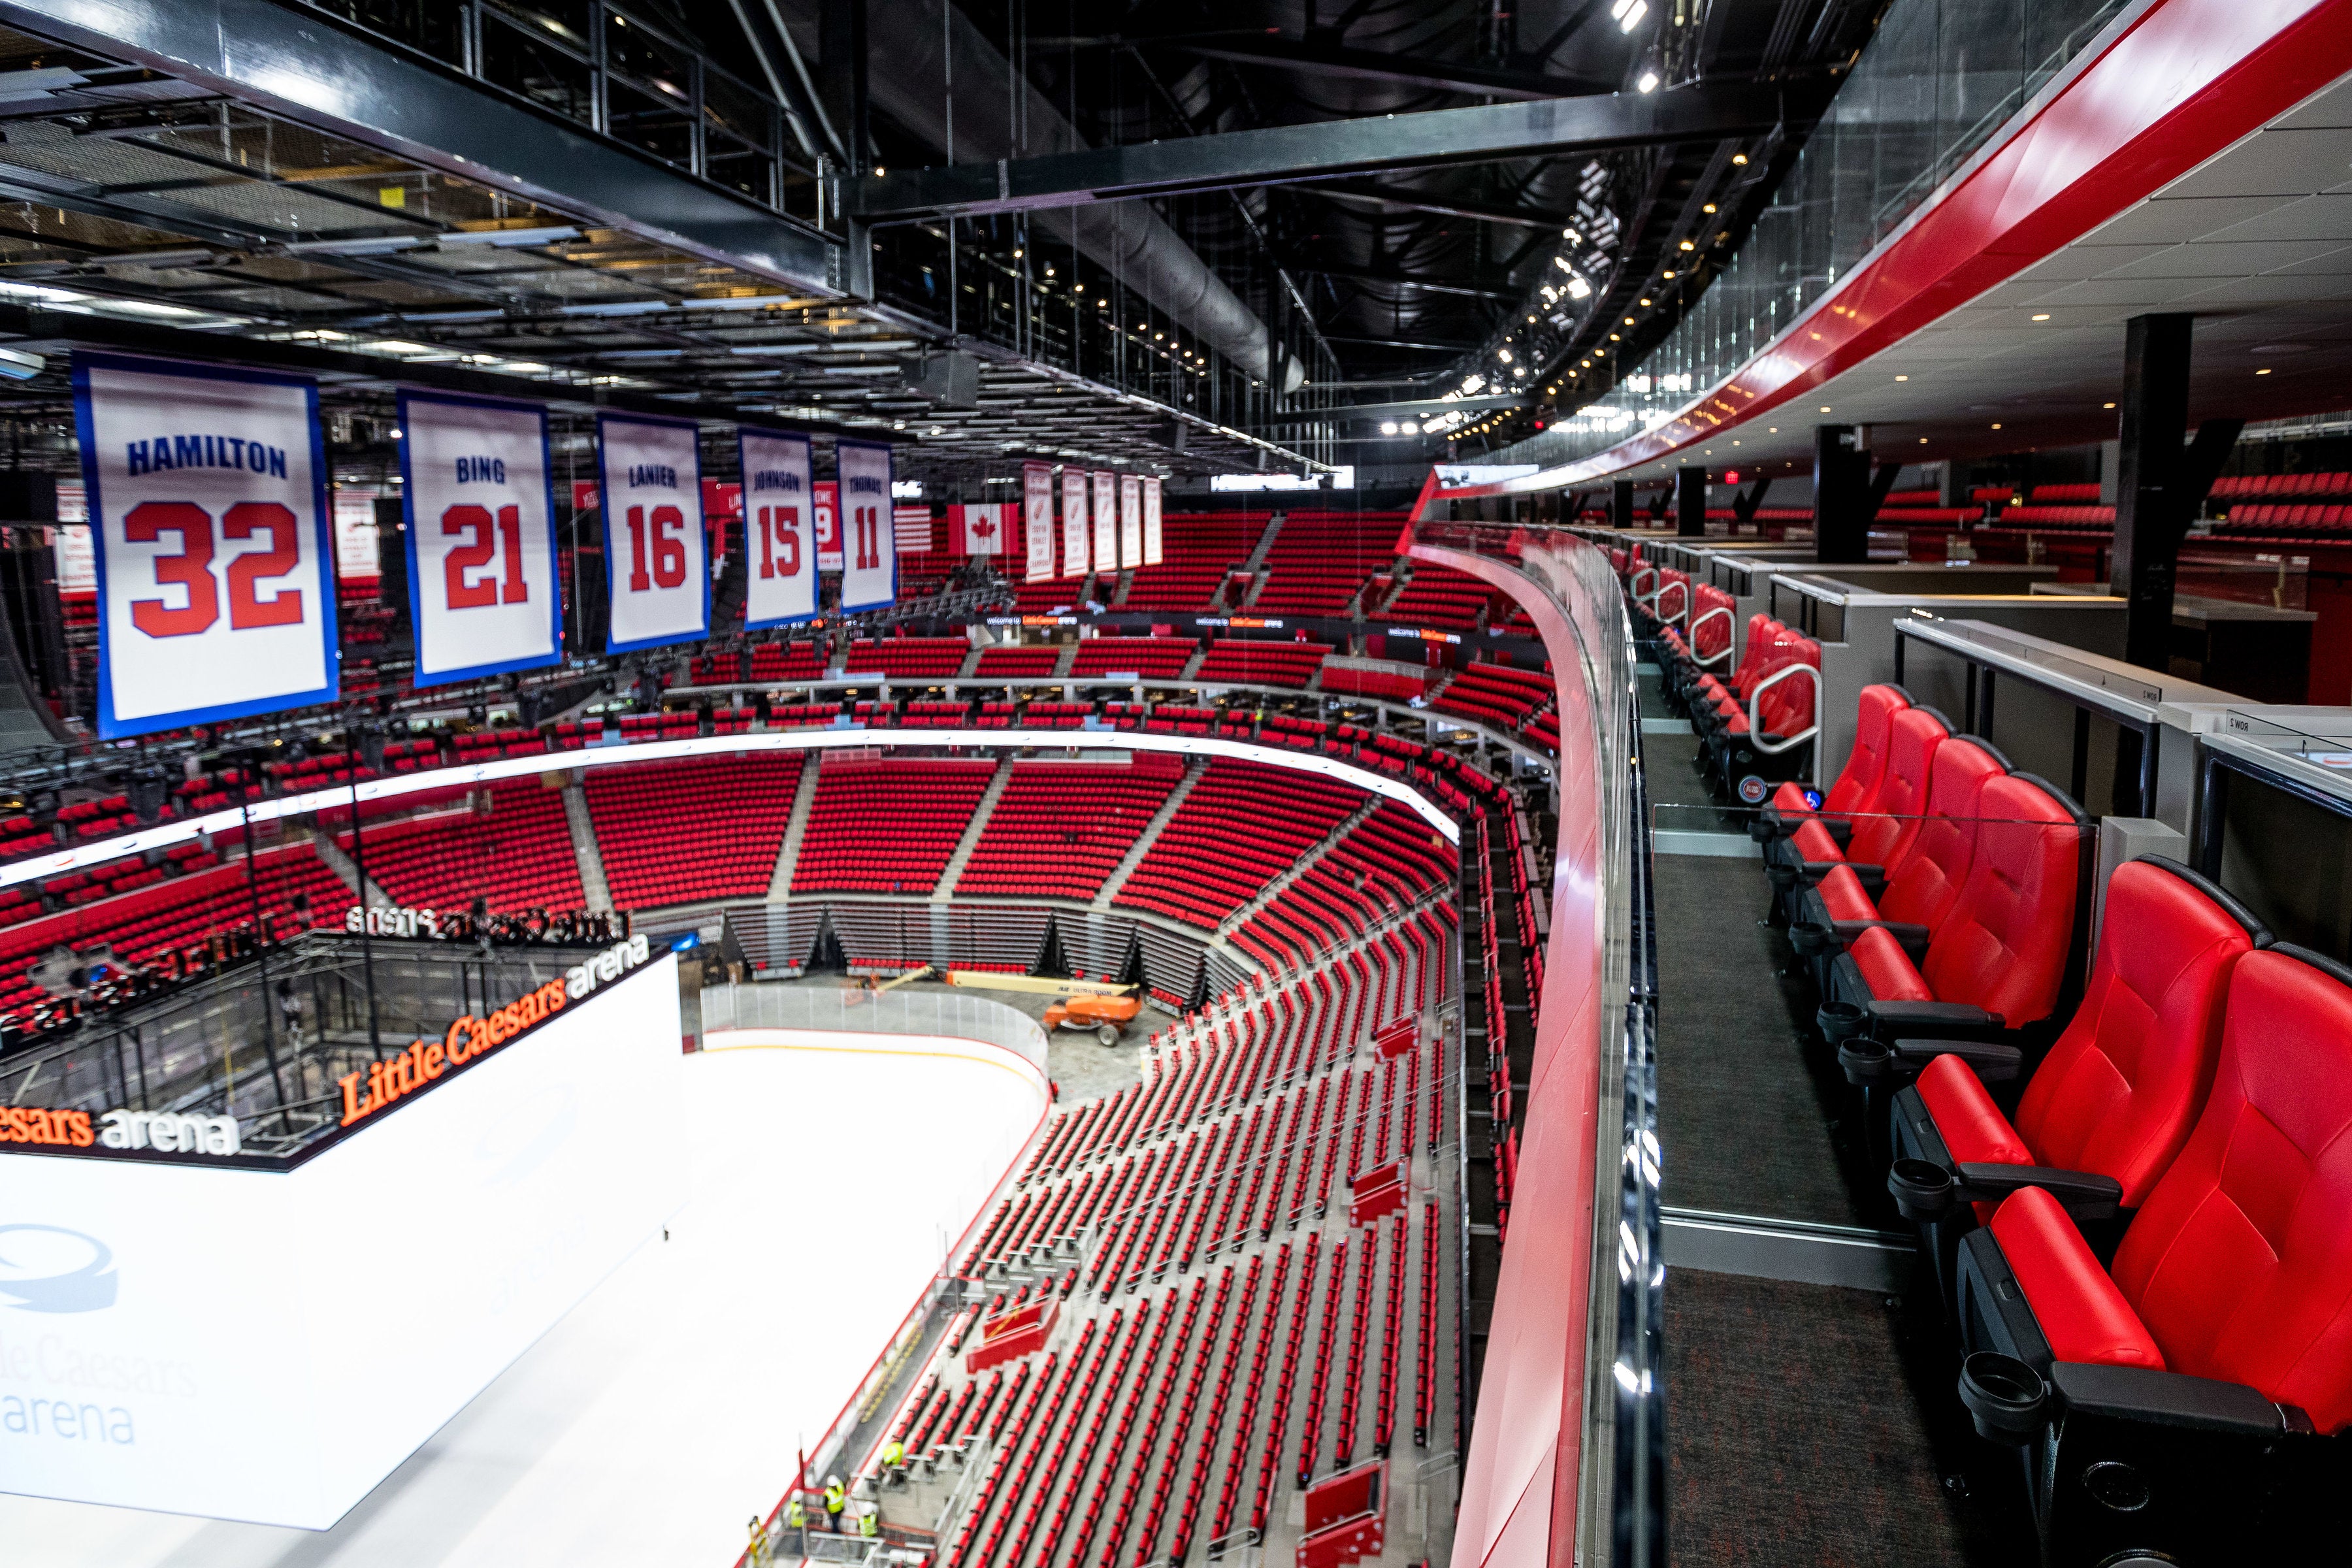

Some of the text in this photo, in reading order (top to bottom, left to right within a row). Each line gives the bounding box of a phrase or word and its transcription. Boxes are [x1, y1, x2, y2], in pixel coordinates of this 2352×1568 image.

[128, 435, 287, 480] HAMILTON
[456, 456, 505, 484] BING
[628, 464, 678, 489] LANIER
[754, 470, 800, 492] JOHNSON
[814, 490, 834, 505] OWE
[849, 476, 881, 495] THOMAS
[627, 504, 685, 592] 16
[758, 506, 800, 579] 15
[814, 507, 833, 544] 9
[855, 506, 880, 570] 11
[123, 501, 304, 638] 32
[441, 503, 528, 610] 21
[987, 616, 1012, 625] welcome
[1013, 616, 1021, 625] to
[1058, 616, 1077, 625] arena
[1196, 617, 1221, 626] welcome
[1264, 619, 1283, 628] arena
[1388, 627, 1414, 638] welcome
[1415, 629, 1420, 638] to
[1446, 634, 1461, 644] arena
[339, 934, 649, 1126] Little Caesars arena
[100, 1109, 241, 1156] arena
[36, 1332, 199, 1399] Caesars
[2, 1394, 136, 1446] arena
